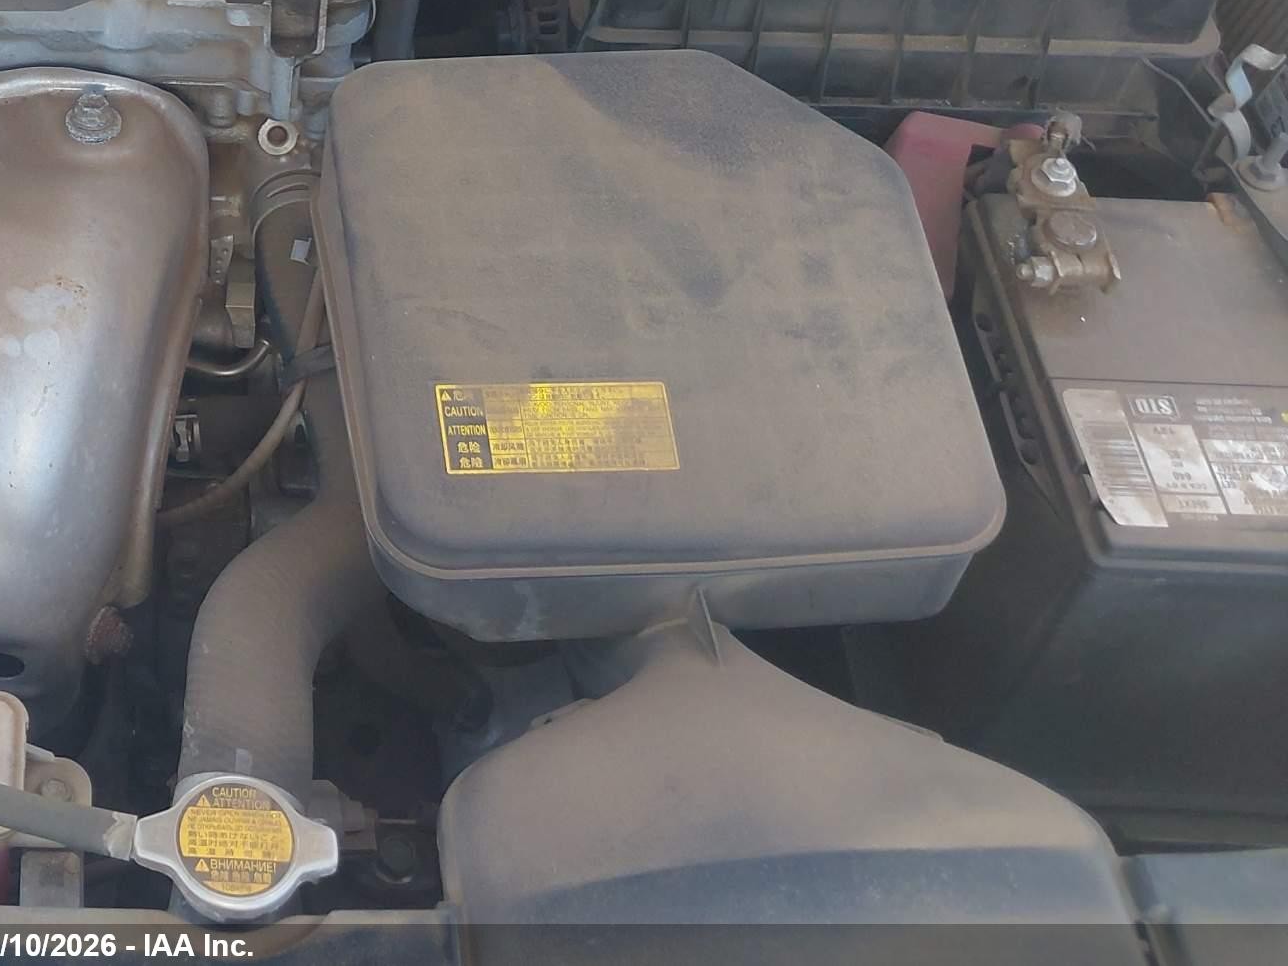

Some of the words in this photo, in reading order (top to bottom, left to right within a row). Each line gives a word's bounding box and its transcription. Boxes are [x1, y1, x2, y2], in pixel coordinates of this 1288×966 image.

[444, 405, 484, 418] CAUTION
[447, 424, 486, 436] ATTENTION
[212, 786, 257, 800] CAUTION
[212, 798, 271, 811] ATTENTION
[210, 858, 277, 874] ВНИМАНИЕ!
